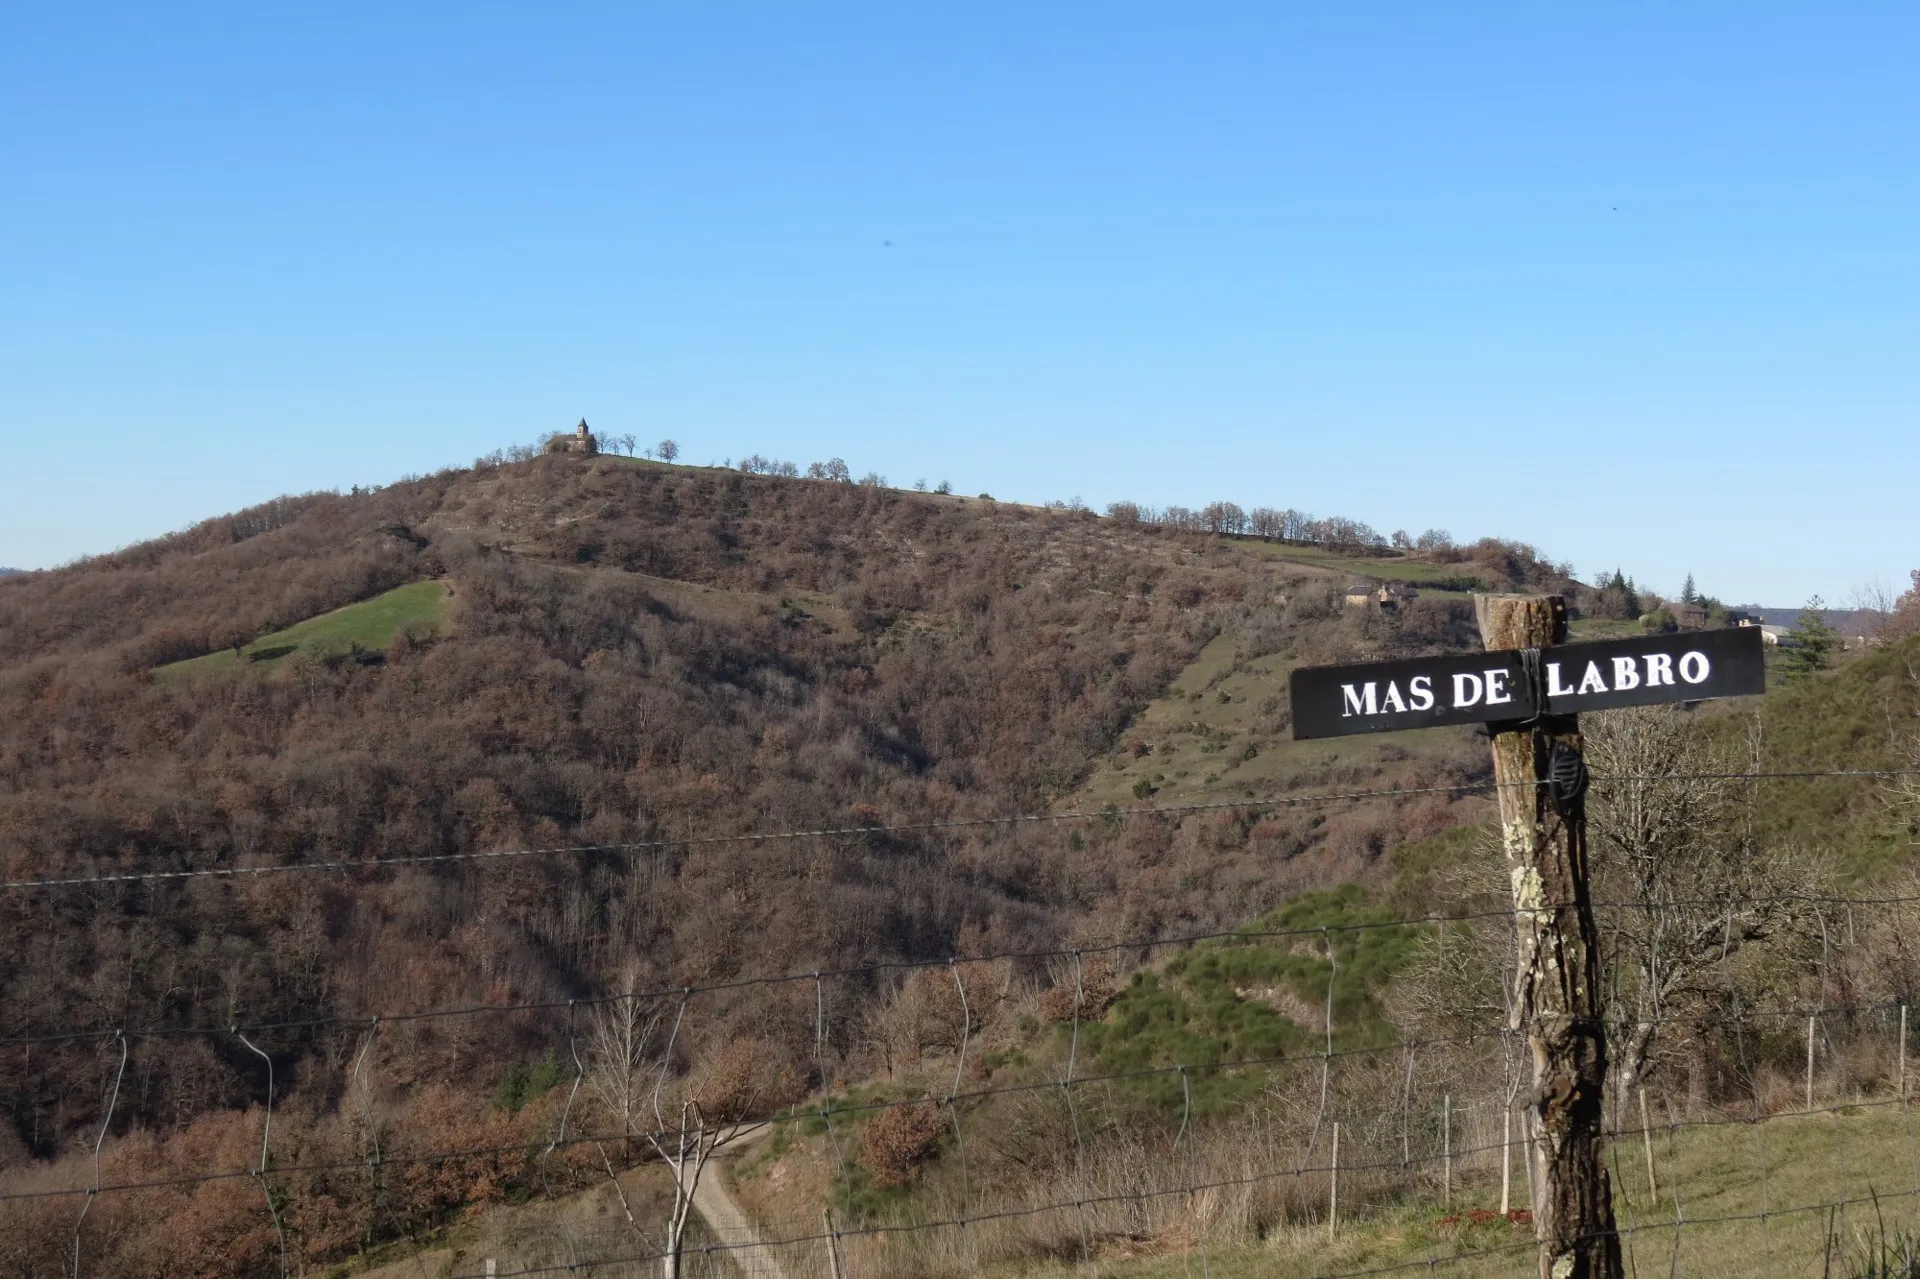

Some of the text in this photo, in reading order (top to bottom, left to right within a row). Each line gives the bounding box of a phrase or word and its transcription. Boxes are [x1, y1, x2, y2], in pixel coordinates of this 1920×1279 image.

[1341, 651, 1710, 717] MAS DE LABRO
